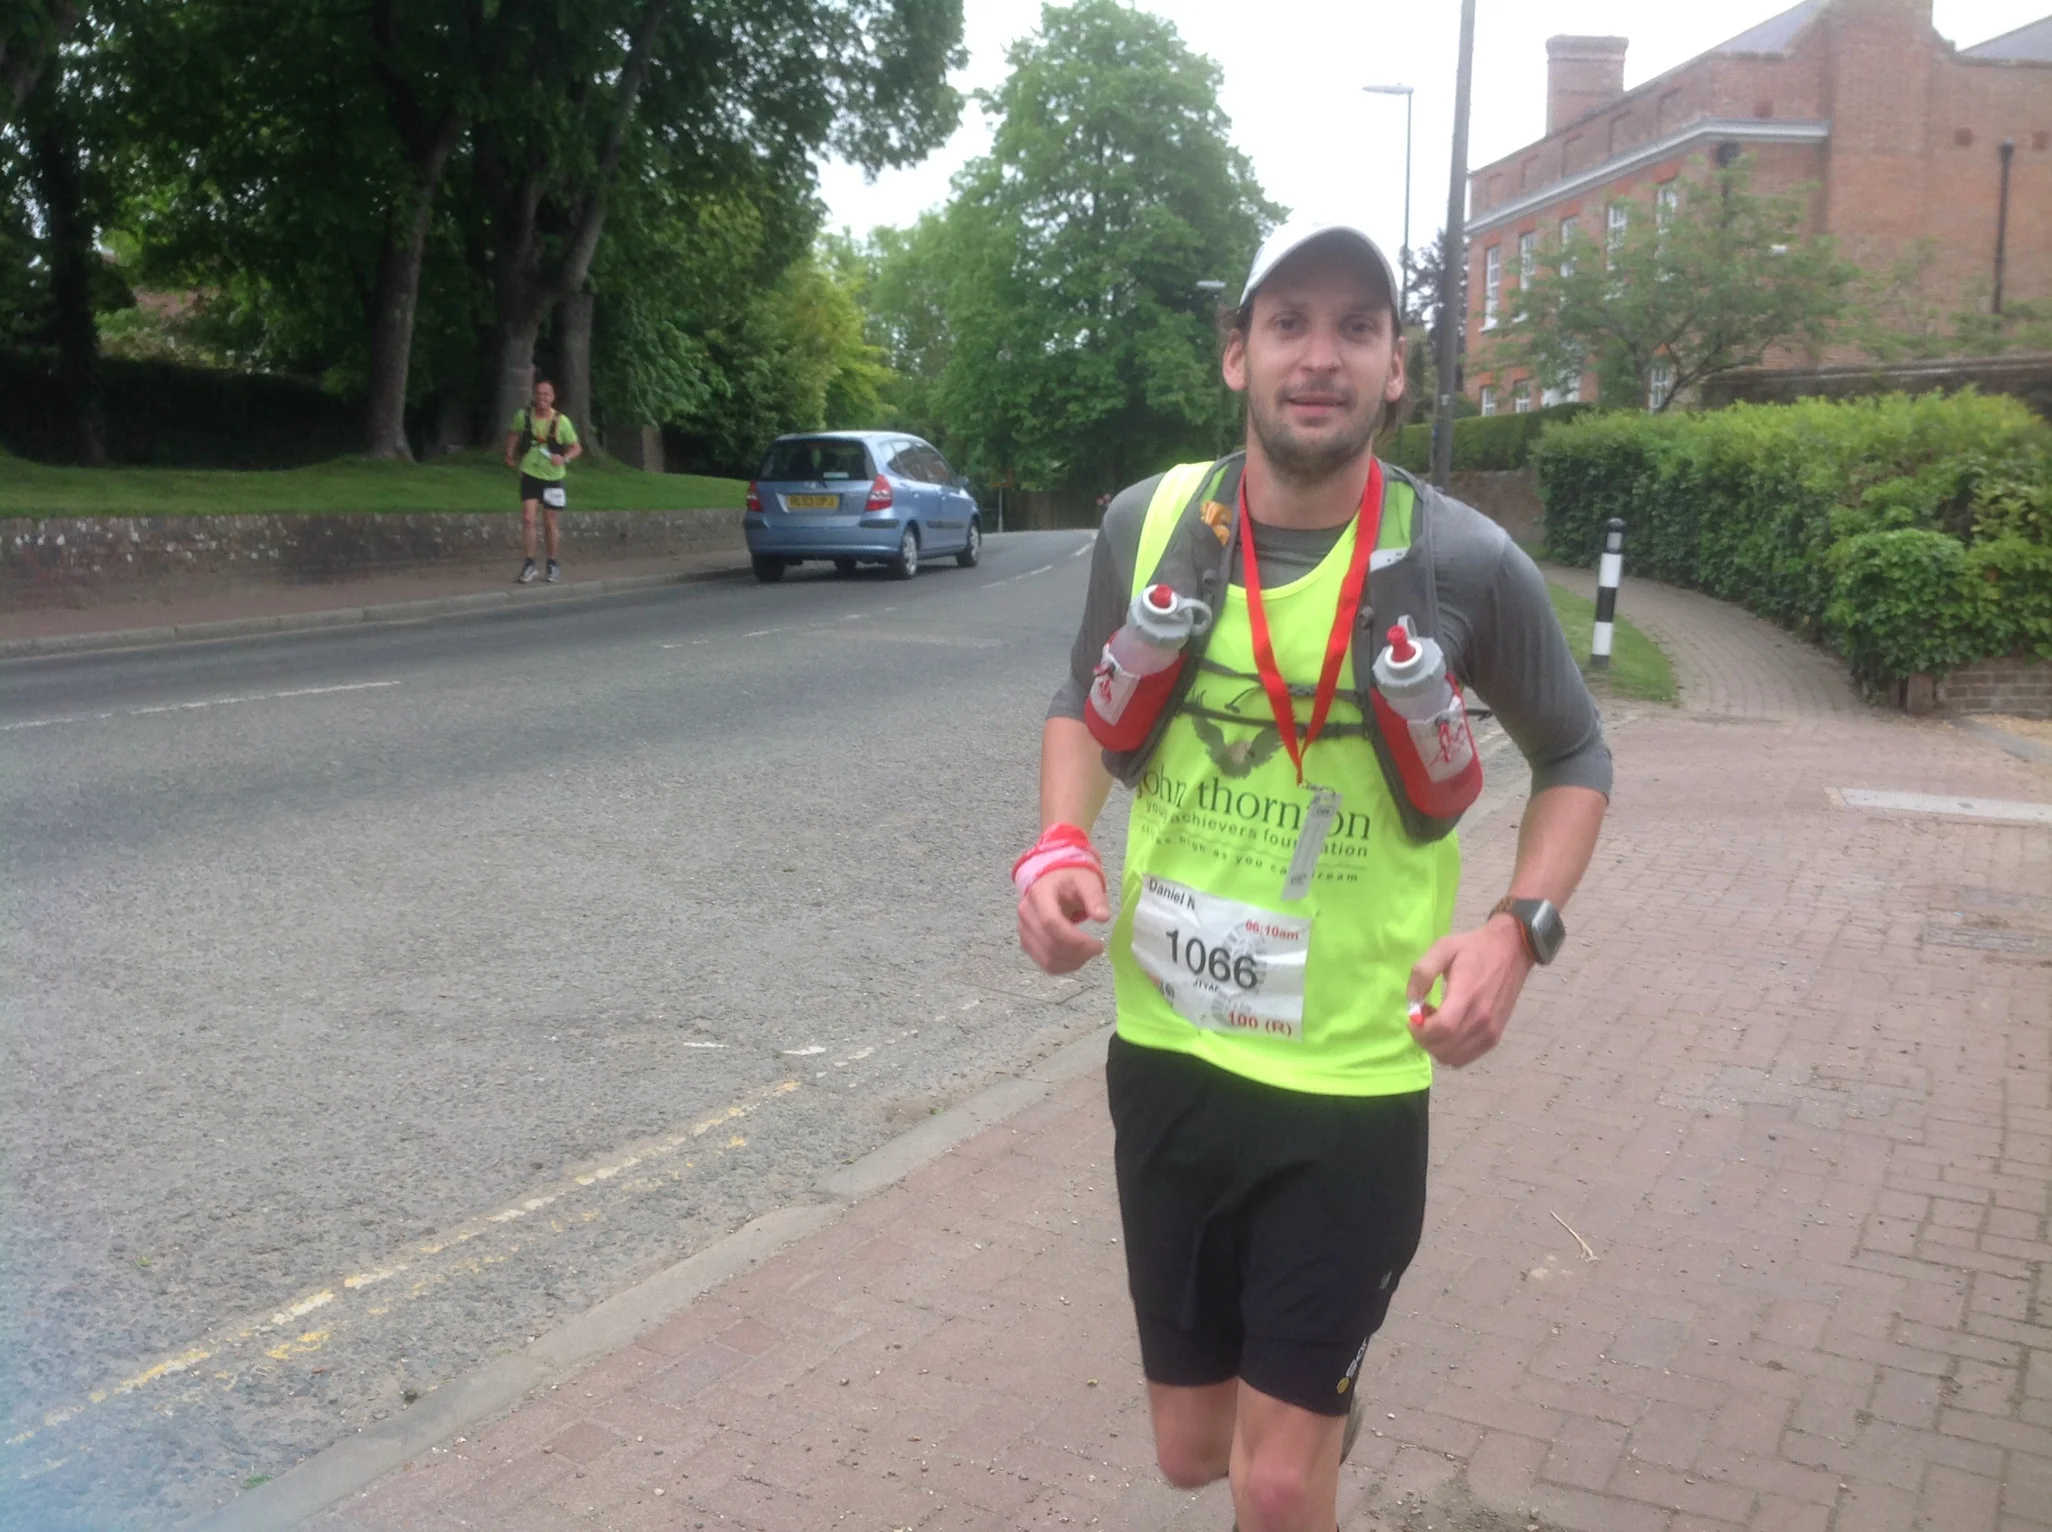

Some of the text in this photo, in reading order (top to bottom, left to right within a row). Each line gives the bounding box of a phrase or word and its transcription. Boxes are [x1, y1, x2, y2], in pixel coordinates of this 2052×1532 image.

[1197, 776, 1371, 841] thornon
[1170, 811, 1257, 840] achievers
[1213, 848, 1227, 861] as
[1236, 855, 1264, 869] you
[1270, 863, 1288, 876] ca
[1149, 877, 1185, 906] Daniel
[1166, 928, 1259, 990] 1066
[1228, 1010, 1259, 1030] 100
